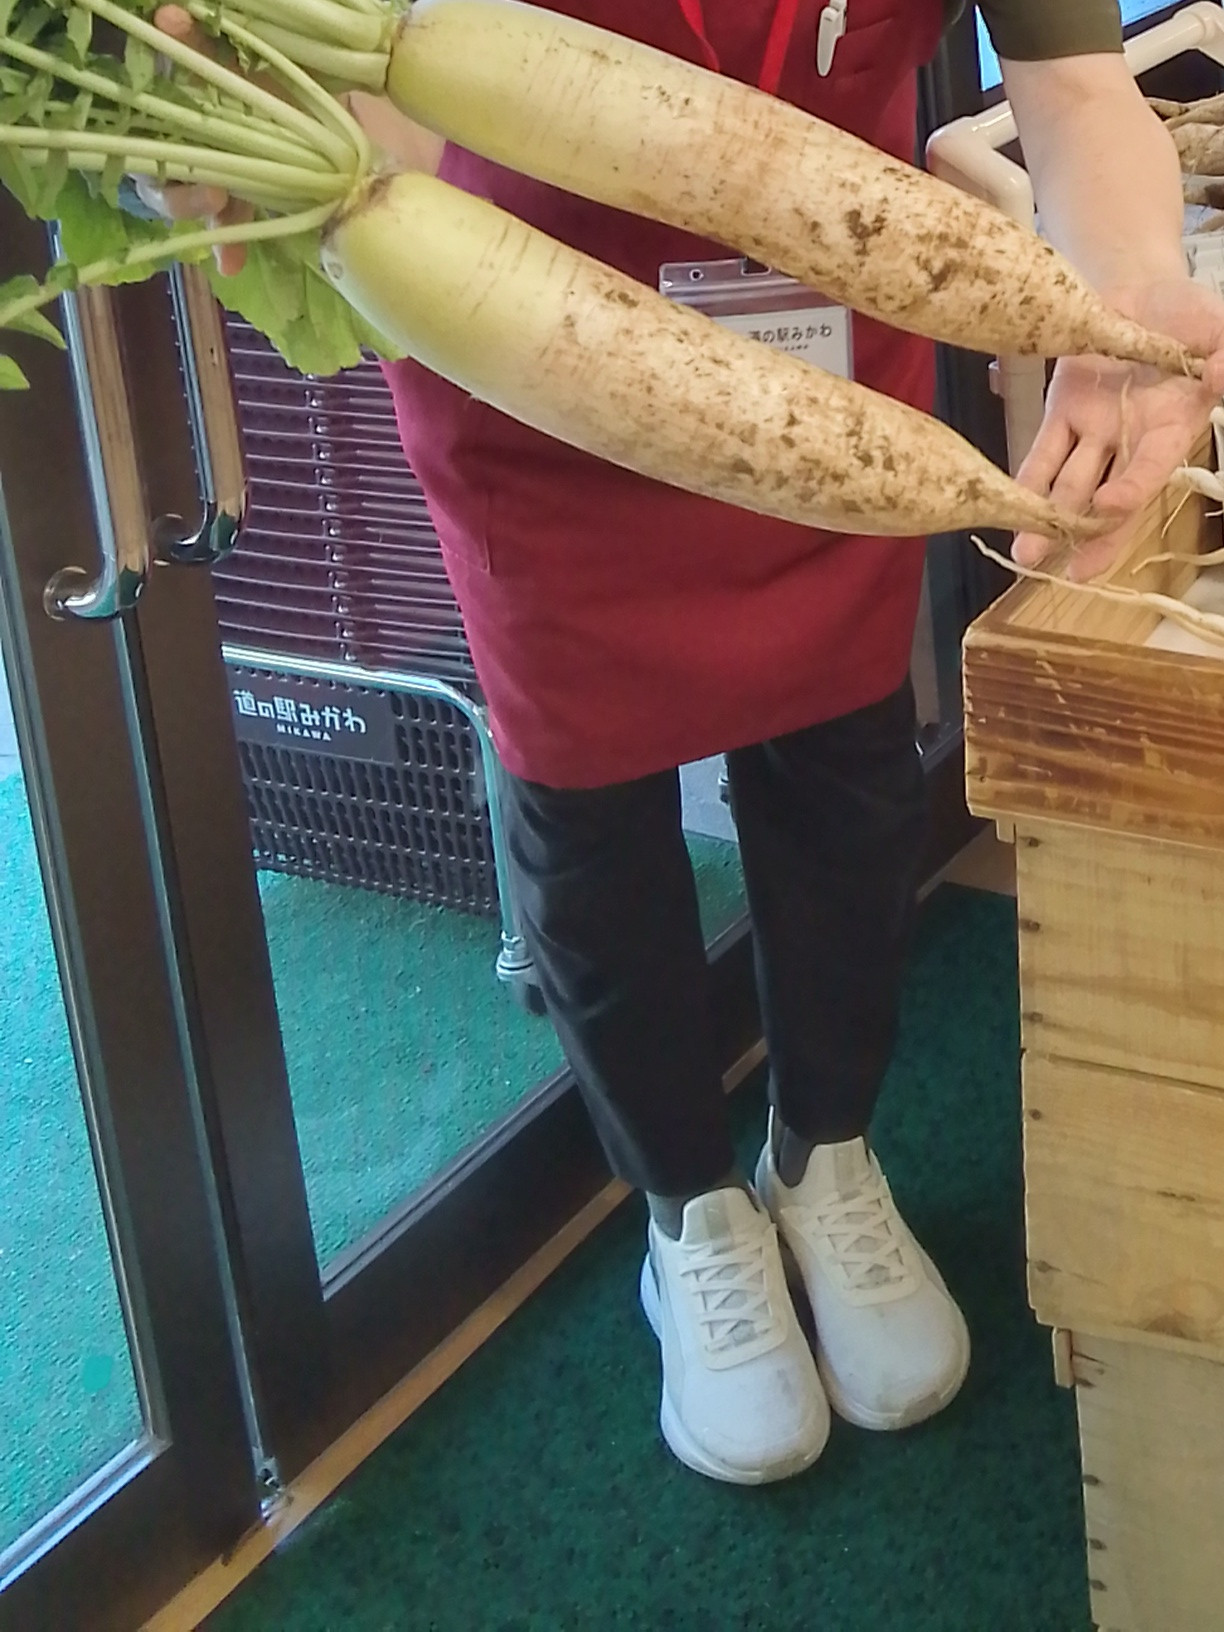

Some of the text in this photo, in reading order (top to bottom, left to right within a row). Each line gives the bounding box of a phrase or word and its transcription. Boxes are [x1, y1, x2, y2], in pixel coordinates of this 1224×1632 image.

[233, 689, 367, 734] 道の駅みかわ
[276, 724, 332, 741] MIKAWA
